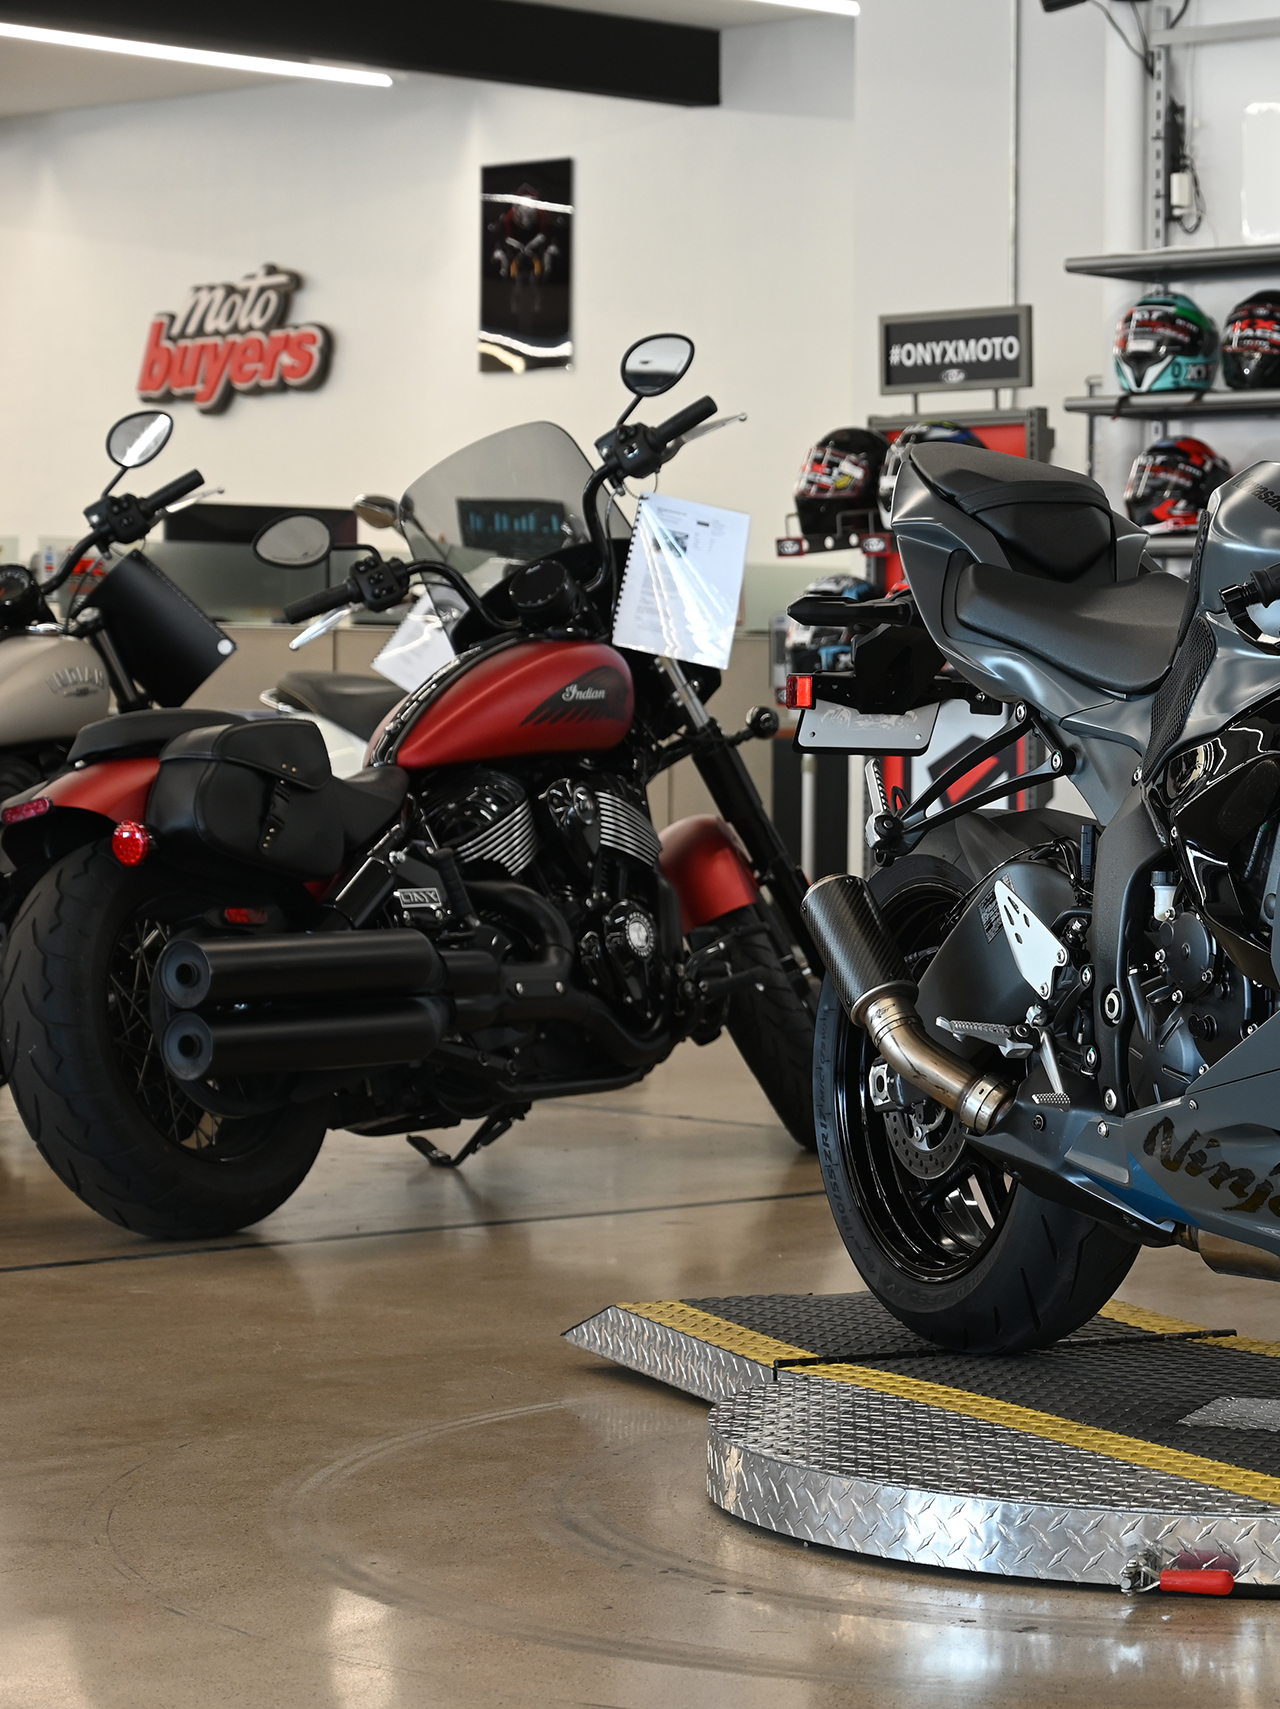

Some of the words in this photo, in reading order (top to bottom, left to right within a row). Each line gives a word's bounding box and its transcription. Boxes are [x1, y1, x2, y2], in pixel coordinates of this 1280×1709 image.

[136, 317, 322, 407] buyers
[888, 335, 1020, 367] #ONYXMOTO
[562, 683, 605, 702] Indian
[826, 1168, 854, 1232] 180/55
